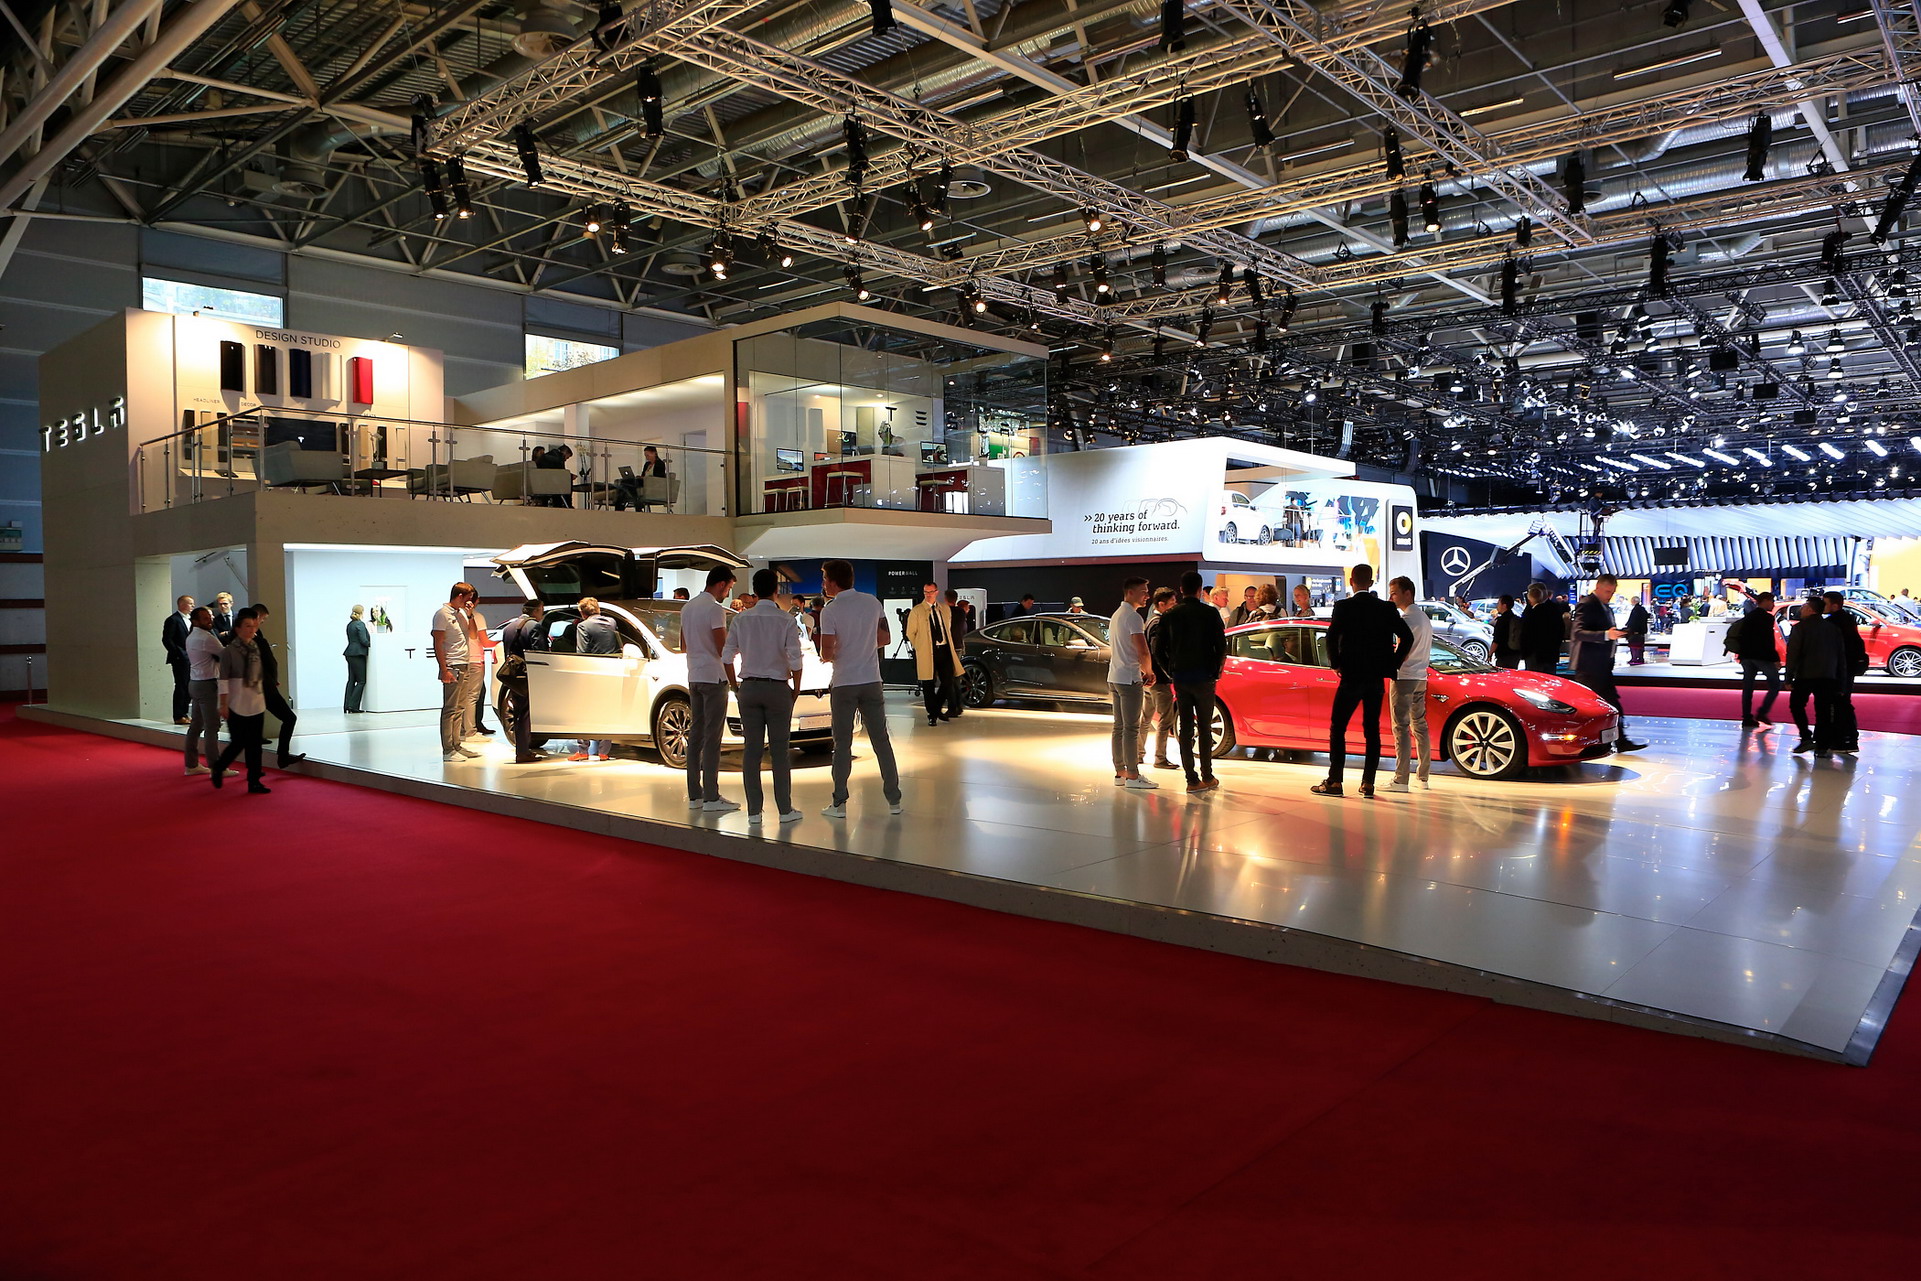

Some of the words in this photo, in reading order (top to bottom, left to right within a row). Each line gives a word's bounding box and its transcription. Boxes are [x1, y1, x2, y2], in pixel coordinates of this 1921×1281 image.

[255, 329, 297, 343] DESIGN
[301, 336, 341, 349] STUDIO
[39, 396, 125, 452] TESLA
[1094, 512, 1105, 522] 20
[1108, 512, 1135, 524] years
[1138, 510, 1148, 520] of
[1092, 522, 1135, 534] thinking
[1138, 520, 1180, 531] forward.
[1655, 584, 1688, 598] EQ
